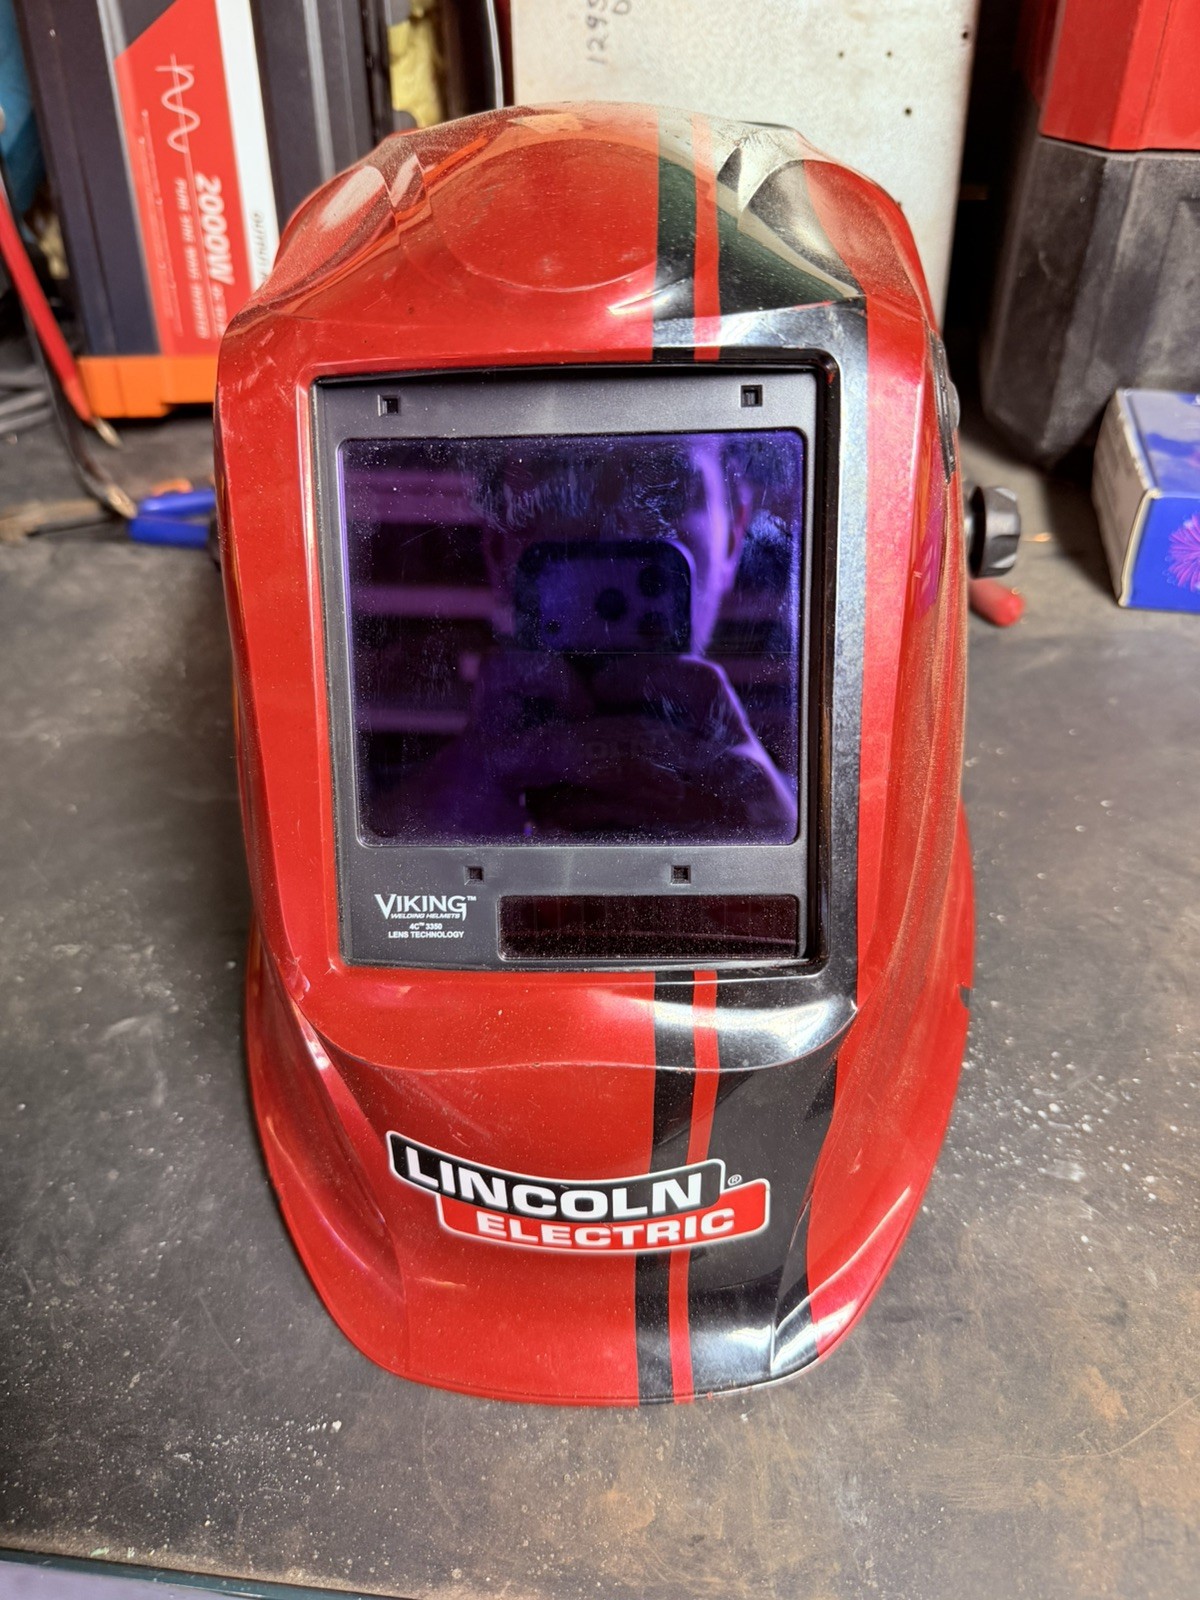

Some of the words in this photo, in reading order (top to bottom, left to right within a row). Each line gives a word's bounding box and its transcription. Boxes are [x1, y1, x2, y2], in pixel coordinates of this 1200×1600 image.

[195, 172, 235, 285] 2000W
[404, 1145, 704, 1220] LINCOLN
[477, 1207, 736, 1248] ELECTRIC
